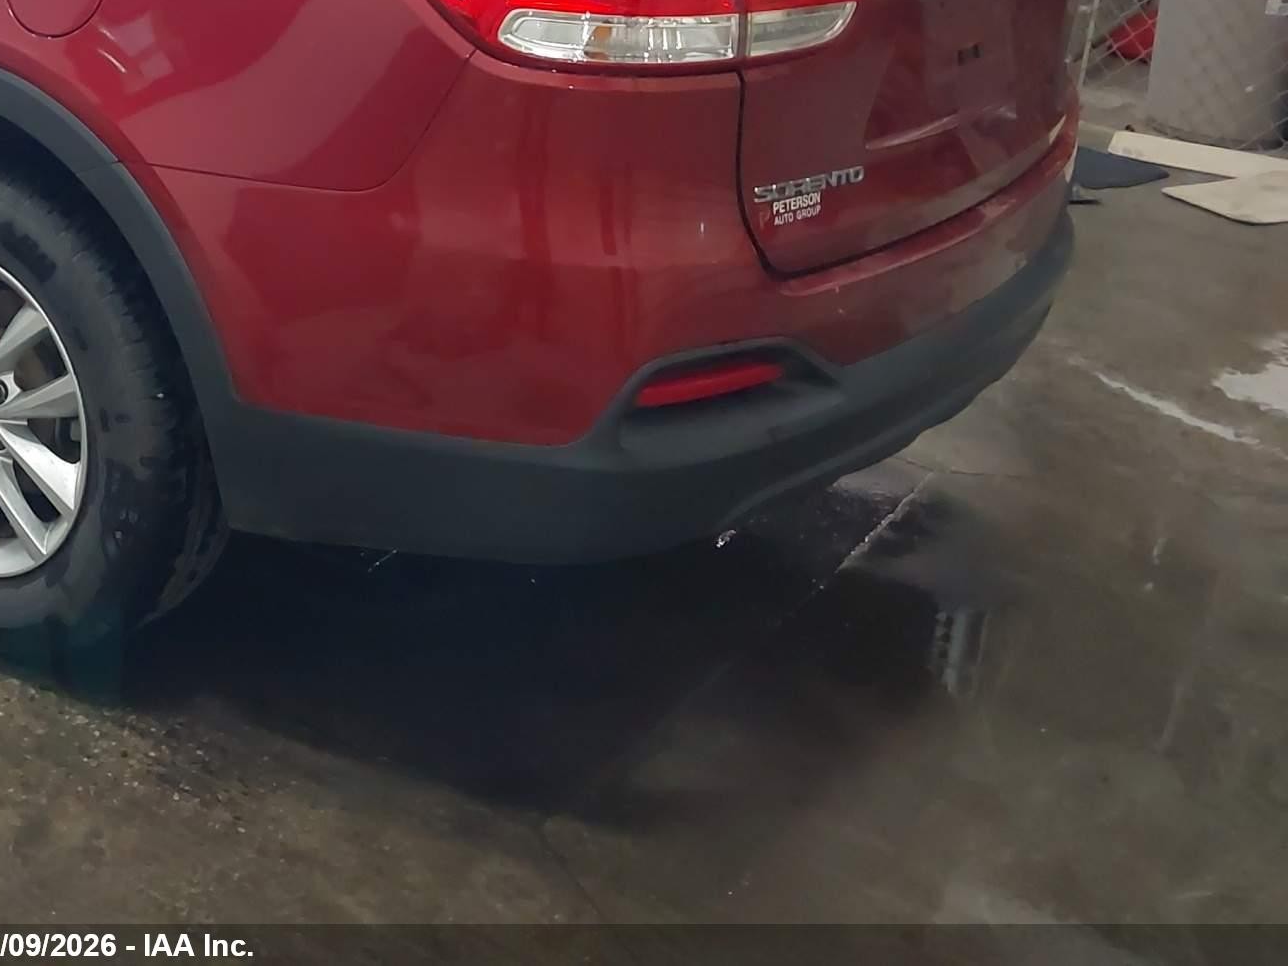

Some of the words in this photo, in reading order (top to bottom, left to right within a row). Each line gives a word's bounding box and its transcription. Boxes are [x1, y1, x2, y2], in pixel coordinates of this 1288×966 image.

[753, 165, 865, 202] SORENTO
[773, 191, 821, 215] PETERSON
[774, 212, 794, 226] AUTO
[796, 205, 822, 220] GROUP
